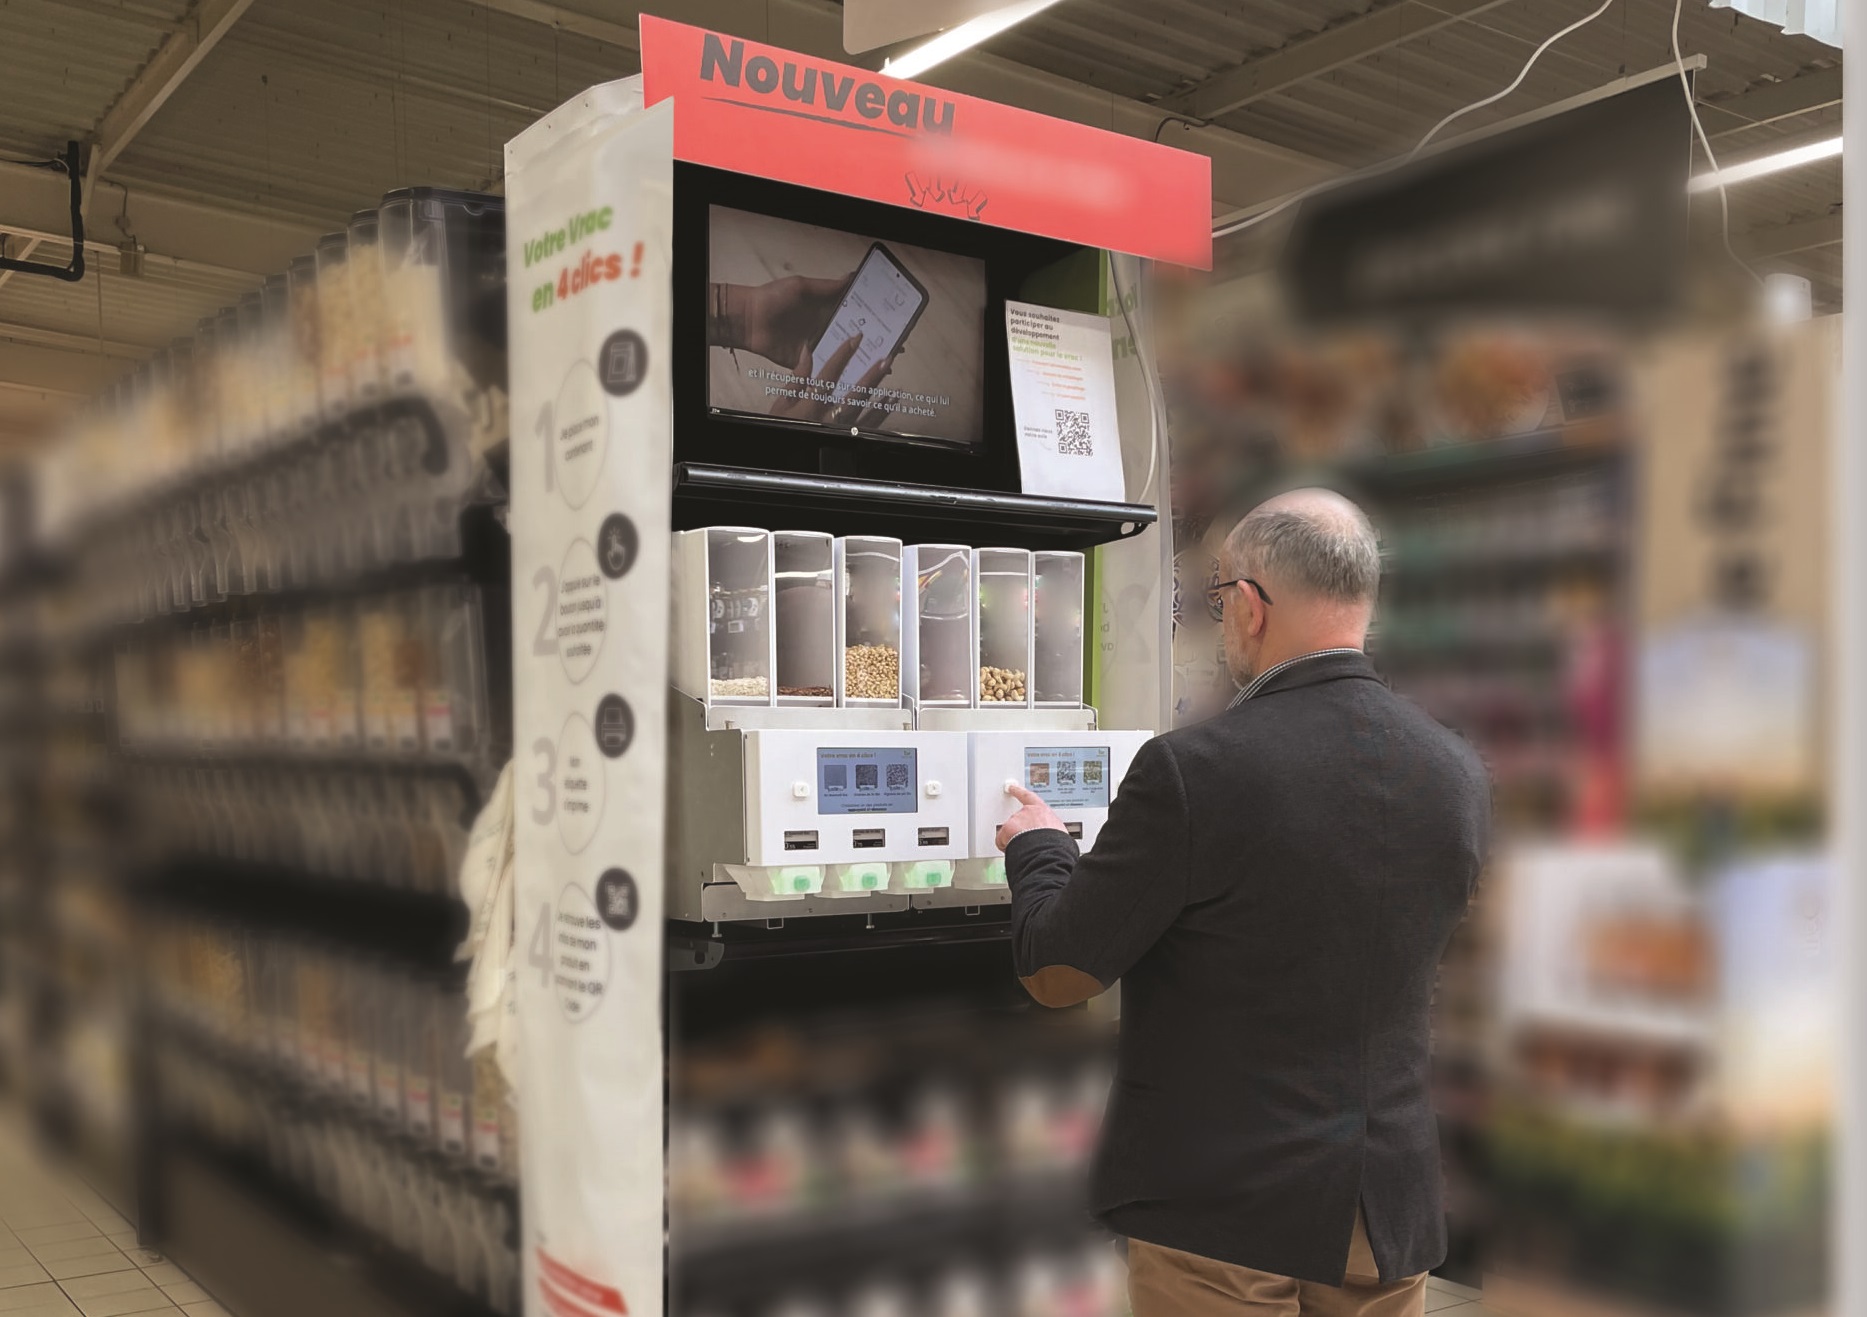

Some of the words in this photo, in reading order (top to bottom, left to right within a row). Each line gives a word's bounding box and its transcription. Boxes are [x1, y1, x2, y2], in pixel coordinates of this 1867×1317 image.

[700, 33, 955, 134] Nouveau
[524, 228, 566, 268] Votre
[568, 205, 613, 246] Vrac
[531, 281, 554, 313] en
[556, 267, 569, 300] 4
[570, 249, 623, 296] clics
[1010, 308, 1027, 318] Vous
[1010, 318, 1043, 330] participer
[1044, 323, 1053, 331] au
[1010, 327, 1060, 341] développement
[1012, 344, 1040, 355] solution
[1040, 349, 1055, 358] pour
[1056, 350, 1063, 358] le
[1064, 353, 1078, 361] vrac
[748, 368, 757, 378] et
[759, 369, 765, 379] il
[766, 371, 805, 385] récupère
[806, 377, 824, 388] tout
[825, 381, 835, 391] ça
[837, 382, 850, 392] sur
[852, 384, 866, 394] son
[868, 386, 914, 401] application,
[915, 393, 924, 402] ce
[926, 394, 938, 406] qui
[939, 395, 950, 406] lui
[765, 385, 797, 398] permet
[798, 389, 809, 400] de
[810, 392, 845, 405] toujours
[847, 398, 872, 408] savoir
[873, 401, 882, 410] ce
[883, 402, 901, 414] qu'il
[902, 405, 907, 413] a
[908, 406, 937, 417] acheté.
[535, 400, 553, 492] 1
[533, 565, 558, 657] 2
[532, 737, 556, 826] 3
[586, 915, 601, 930] les
[528, 902, 554, 988] 4
[577, 938, 597, 951] mon
[579, 959, 590, 971] en
[587, 982, 603, 995] QR
